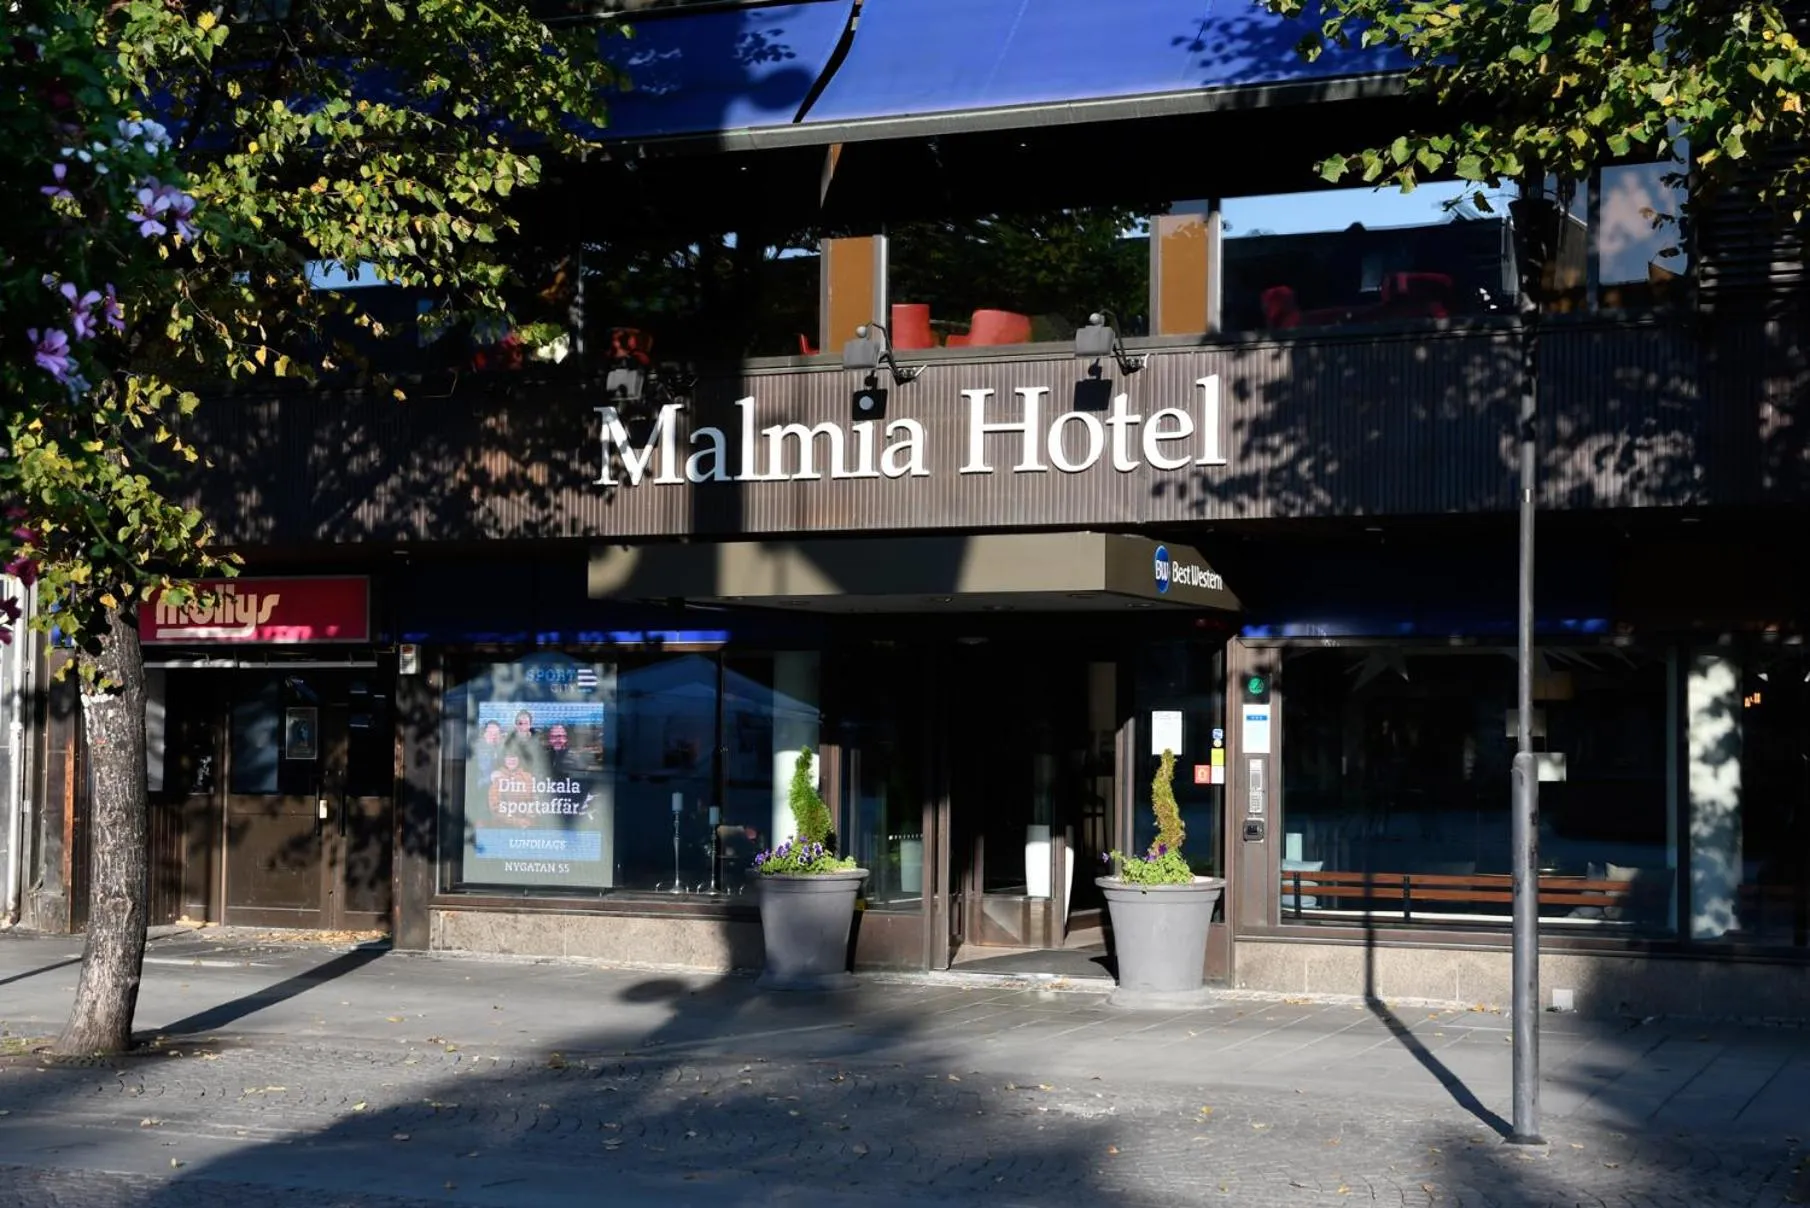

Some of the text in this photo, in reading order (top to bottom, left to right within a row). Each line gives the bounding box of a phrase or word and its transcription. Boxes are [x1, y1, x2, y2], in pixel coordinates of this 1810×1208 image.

[592, 374, 1227, 485] Malmia Hotel
[1172, 561, 1223, 590] Best Western
[526, 668, 574, 682] SPORT
[498, 778, 581, 794] Din lokala
[504, 861, 555, 872] NYGATAN
